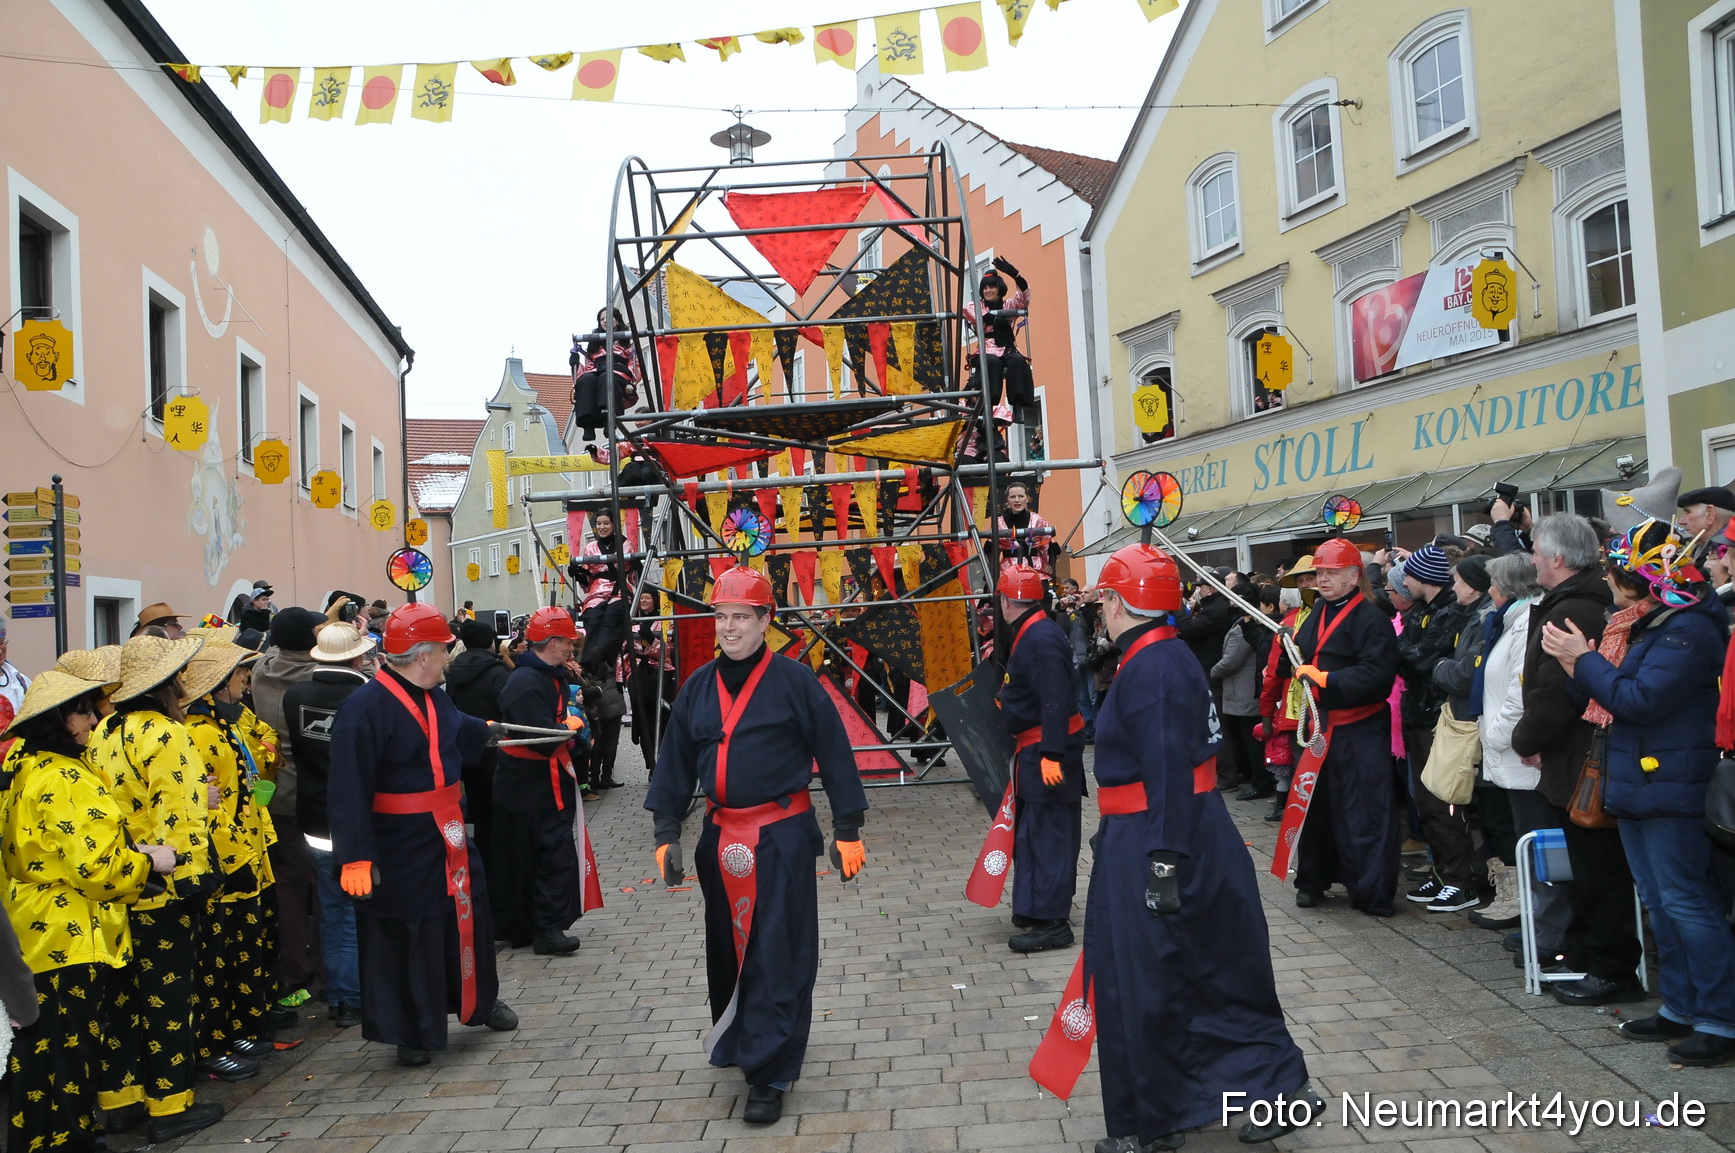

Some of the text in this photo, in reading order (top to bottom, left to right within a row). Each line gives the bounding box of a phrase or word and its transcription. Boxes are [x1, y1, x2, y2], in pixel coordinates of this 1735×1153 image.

[1416, 318, 1482, 343] NEUERÖFFNU
[1450, 328, 1494, 346] MAI 2015
[1412, 363, 1645, 450] KONDITORE
[1253, 420, 1375, 491] STOLL
